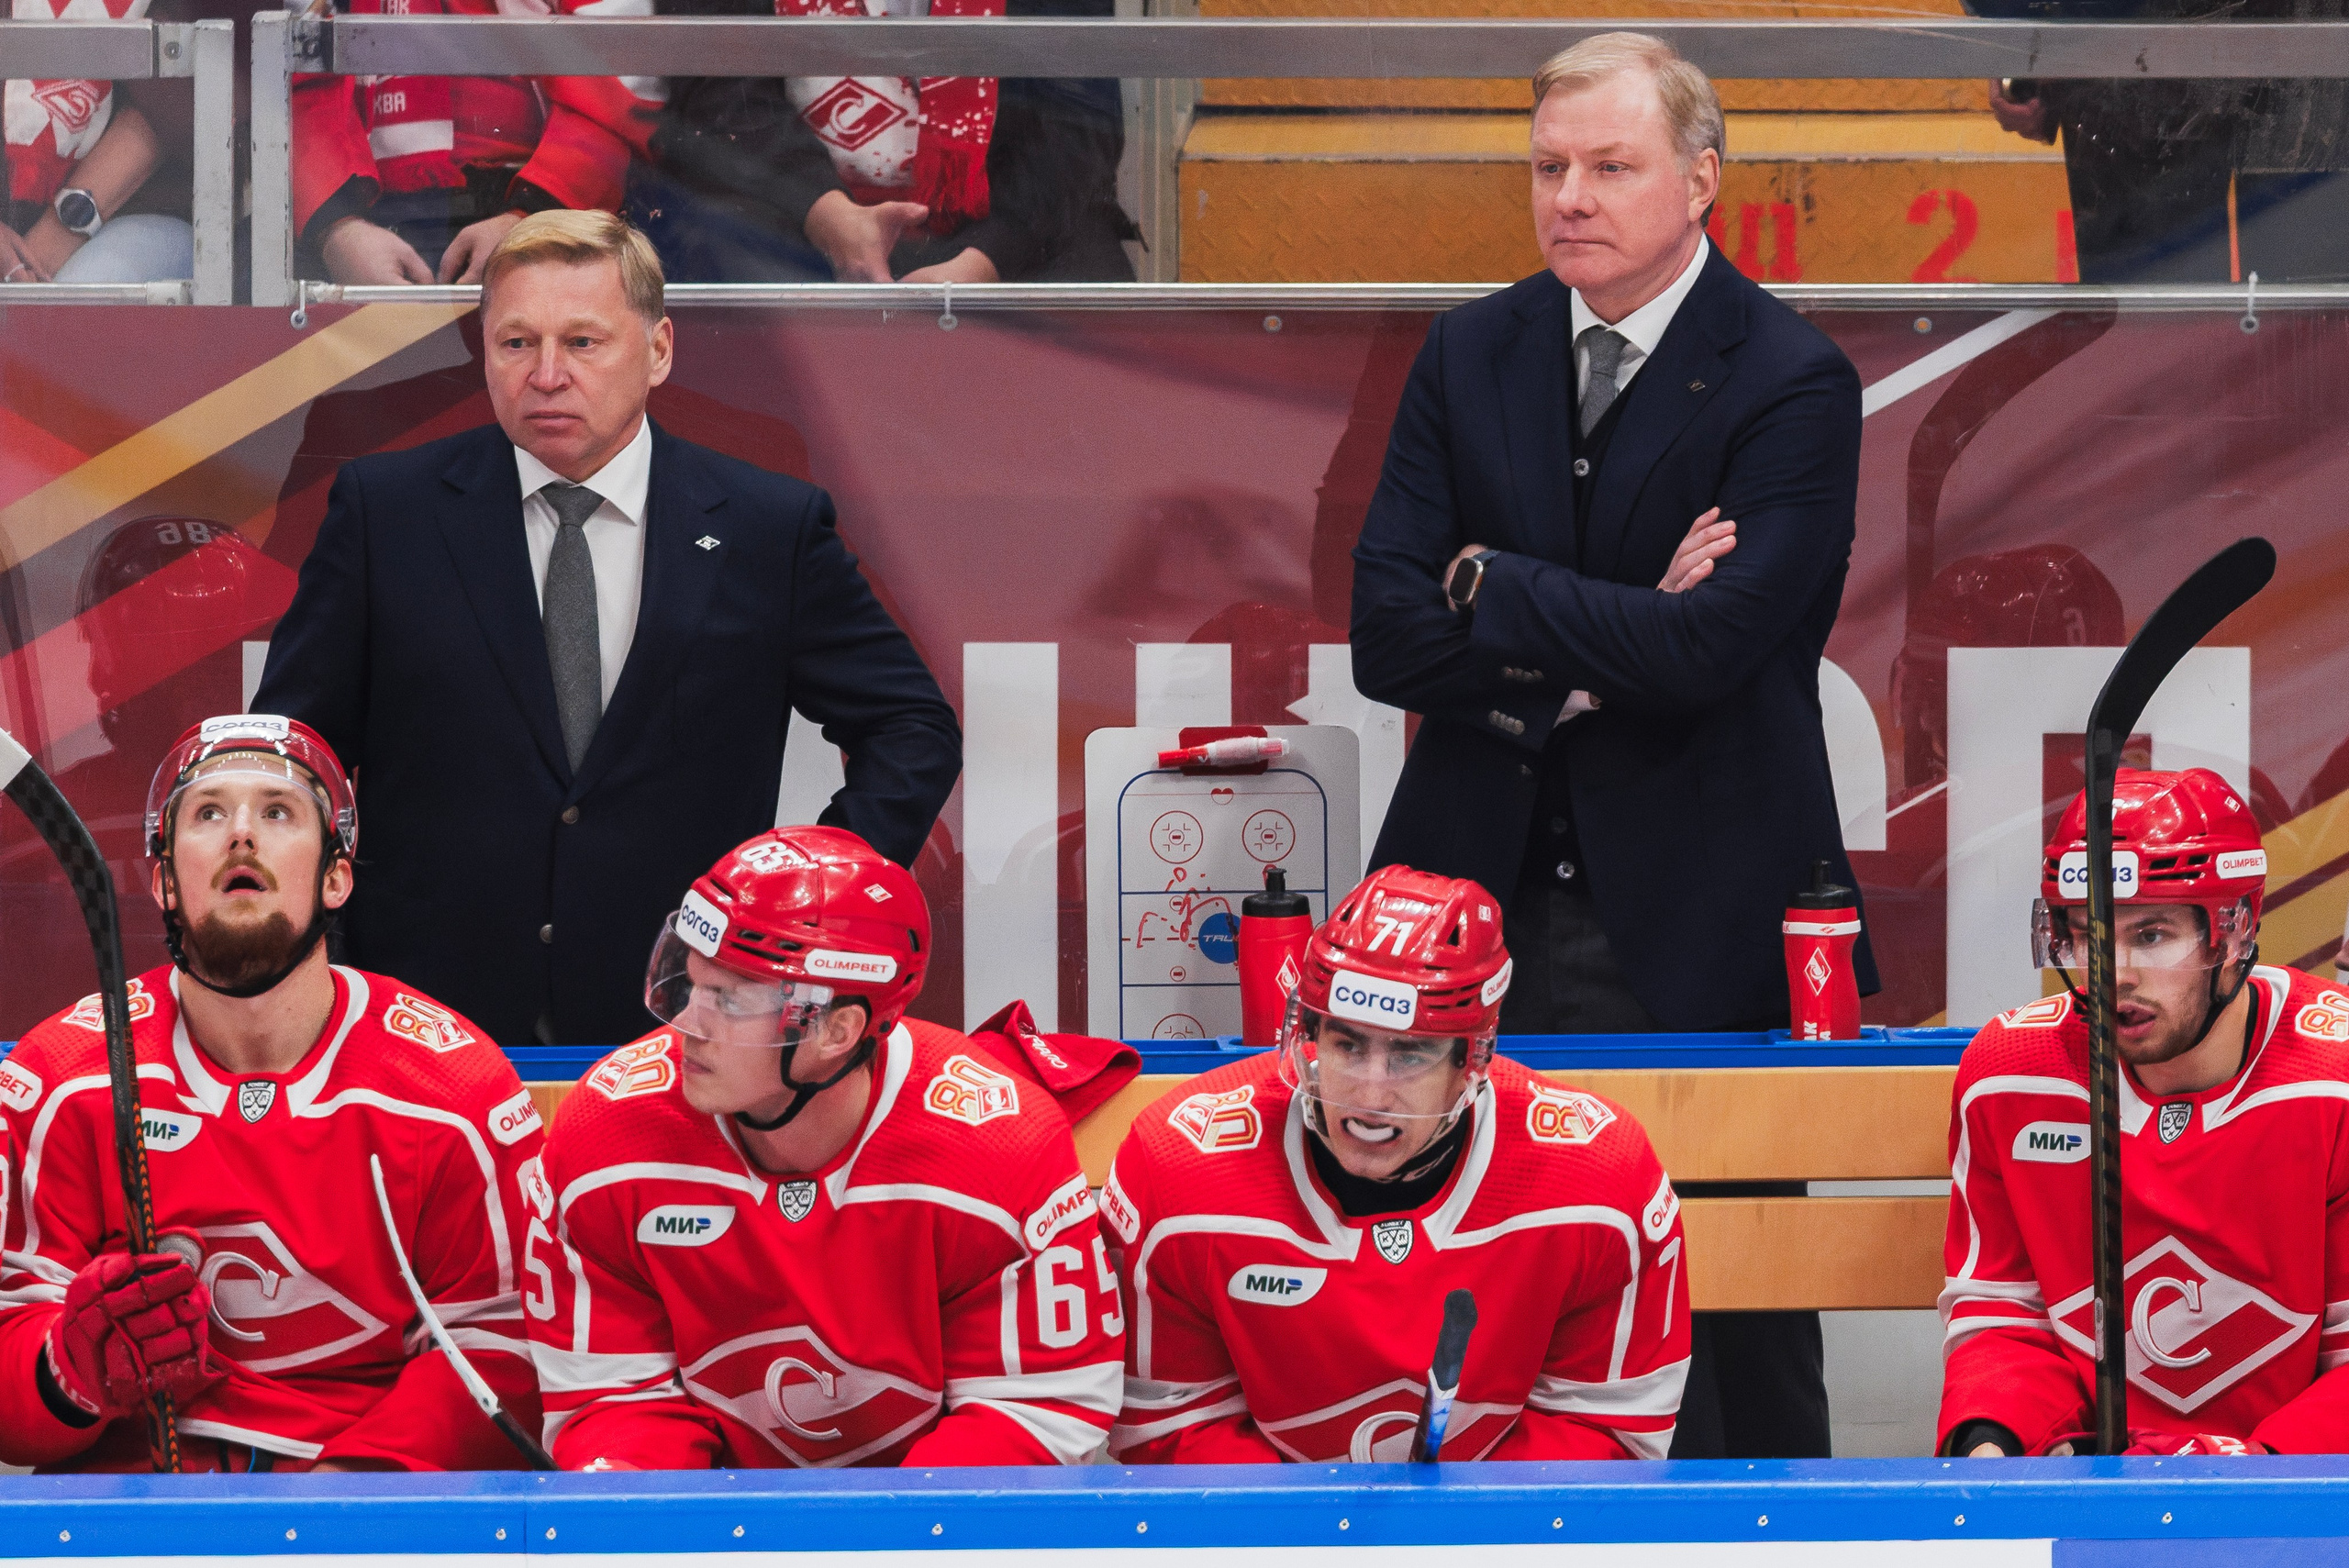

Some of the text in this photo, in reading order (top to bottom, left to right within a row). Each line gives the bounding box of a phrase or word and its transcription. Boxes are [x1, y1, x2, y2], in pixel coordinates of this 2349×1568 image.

[1906, 189, 1979, 283] 2
[740, 841, 819, 873] 65
[2222, 856, 2264, 870] OLIMPBET
[2062, 866, 2132, 884] соз
[1367, 916, 1414, 956] 71
[814, 958, 888, 974] OLIMPBET
[0, 1068, 33, 1098] BET
[2029, 1131, 2083, 1151] МИР
[655, 1215, 711, 1234] МИР
[525, 1216, 556, 1321] 5
[1034, 1234, 1125, 1349] 65
[1245, 1273, 1303, 1295] МИР
